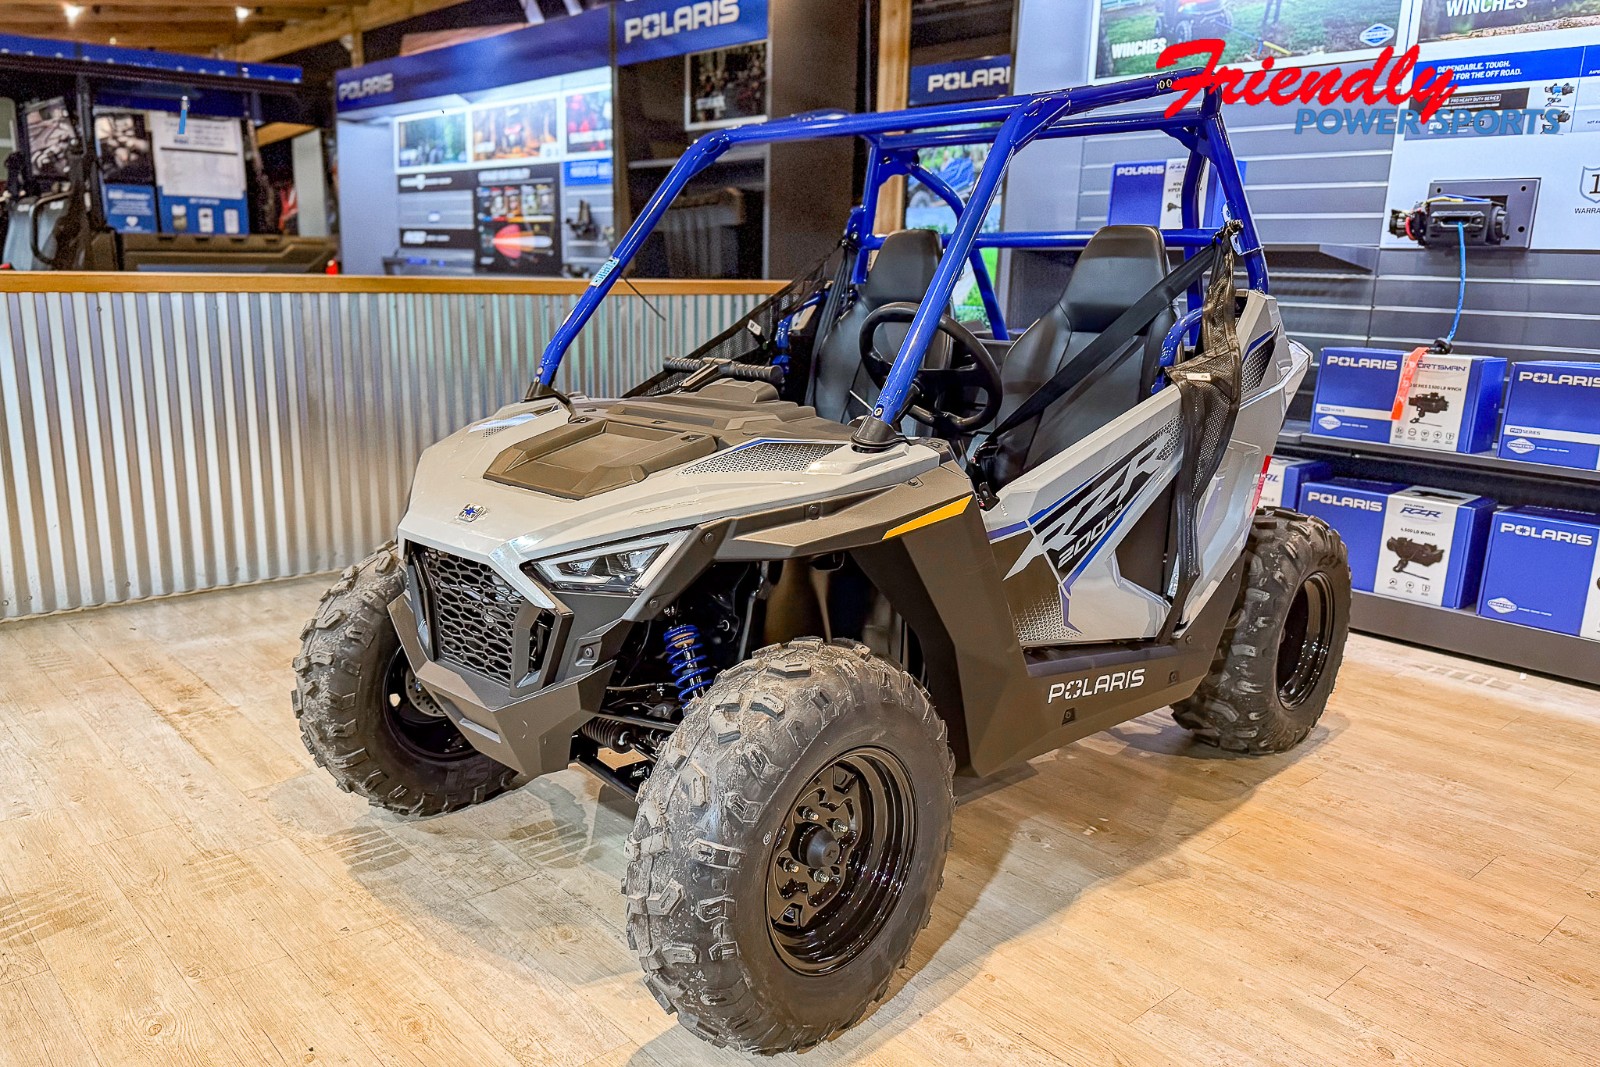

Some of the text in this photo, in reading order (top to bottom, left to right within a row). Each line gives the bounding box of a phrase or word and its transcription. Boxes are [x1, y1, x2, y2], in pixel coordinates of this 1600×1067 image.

[624, 0, 740, 44] POLARIS
[1111, 37, 1167, 59] WINCHES
[1456, 72, 1470, 80] FOR
[1471, 70, 1486, 79] THE
[1486, 70, 1500, 78] OFF
[1500, 68, 1522, 76] ROAD.
[1485, 60, 1511, 69] TOUGH.
[338, 72, 394, 102] POLARIS
[1116, 165, 1164, 176] POLARIS
[1327, 356, 1398, 370] POLARIS
[1404, 362, 1466, 372] ORTSMAN
[1003, 431, 1167, 581] RZR
[1308, 492, 1382, 512] POLARIS
[1400, 507, 1443, 518] RZR
[1057, 516, 1108, 570] 200
[1500, 522, 1592, 546] POLARIS
[1048, 668, 1146, 704] POLARIS
